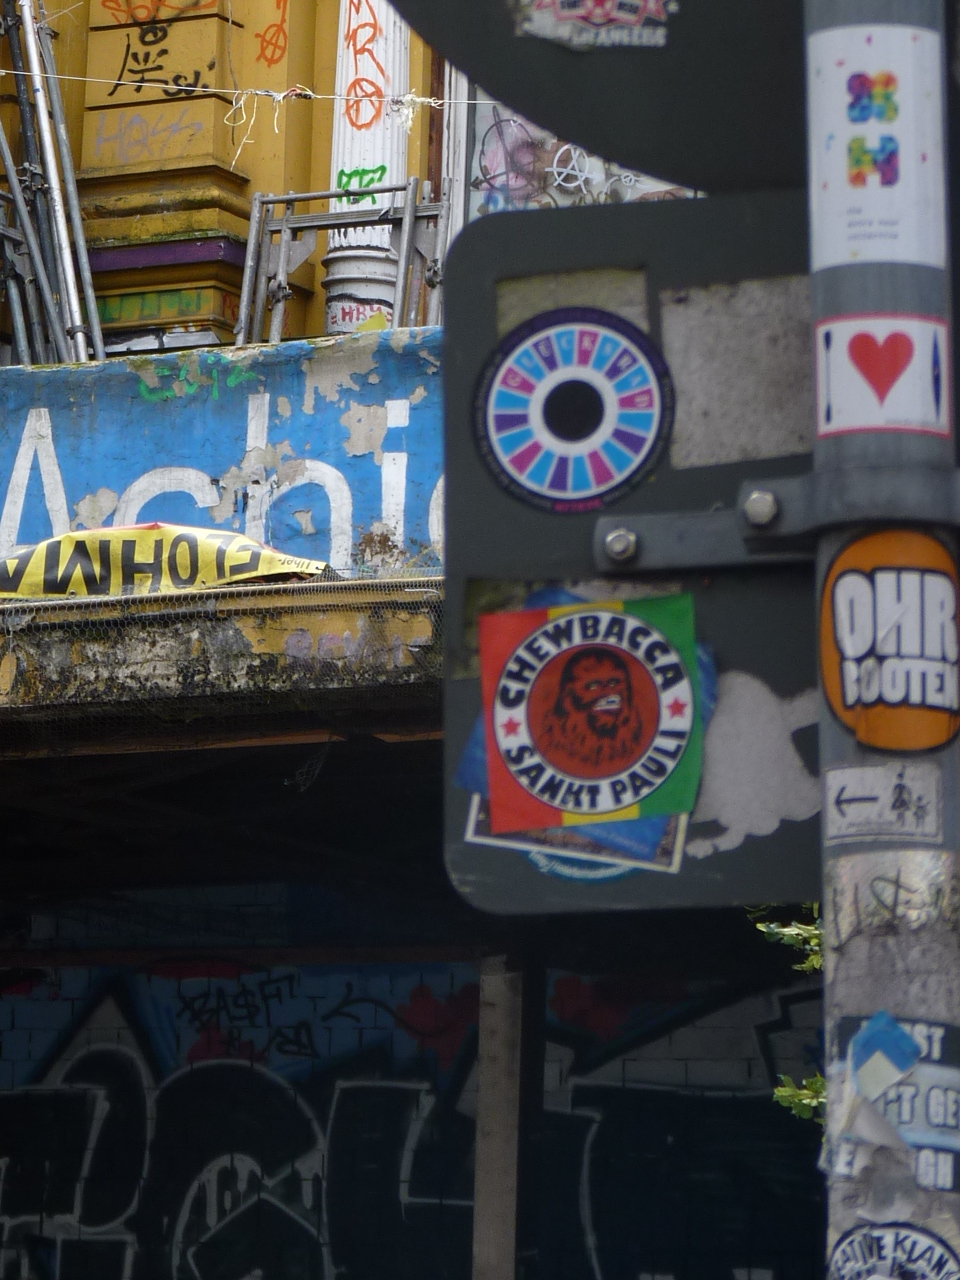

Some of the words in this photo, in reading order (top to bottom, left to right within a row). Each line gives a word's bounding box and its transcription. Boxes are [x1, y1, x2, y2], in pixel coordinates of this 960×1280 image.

[498, 614, 685, 709] CHEWBACCA
[504, 744, 601, 809] SANKT
[609, 729, 688, 805] PAULI
